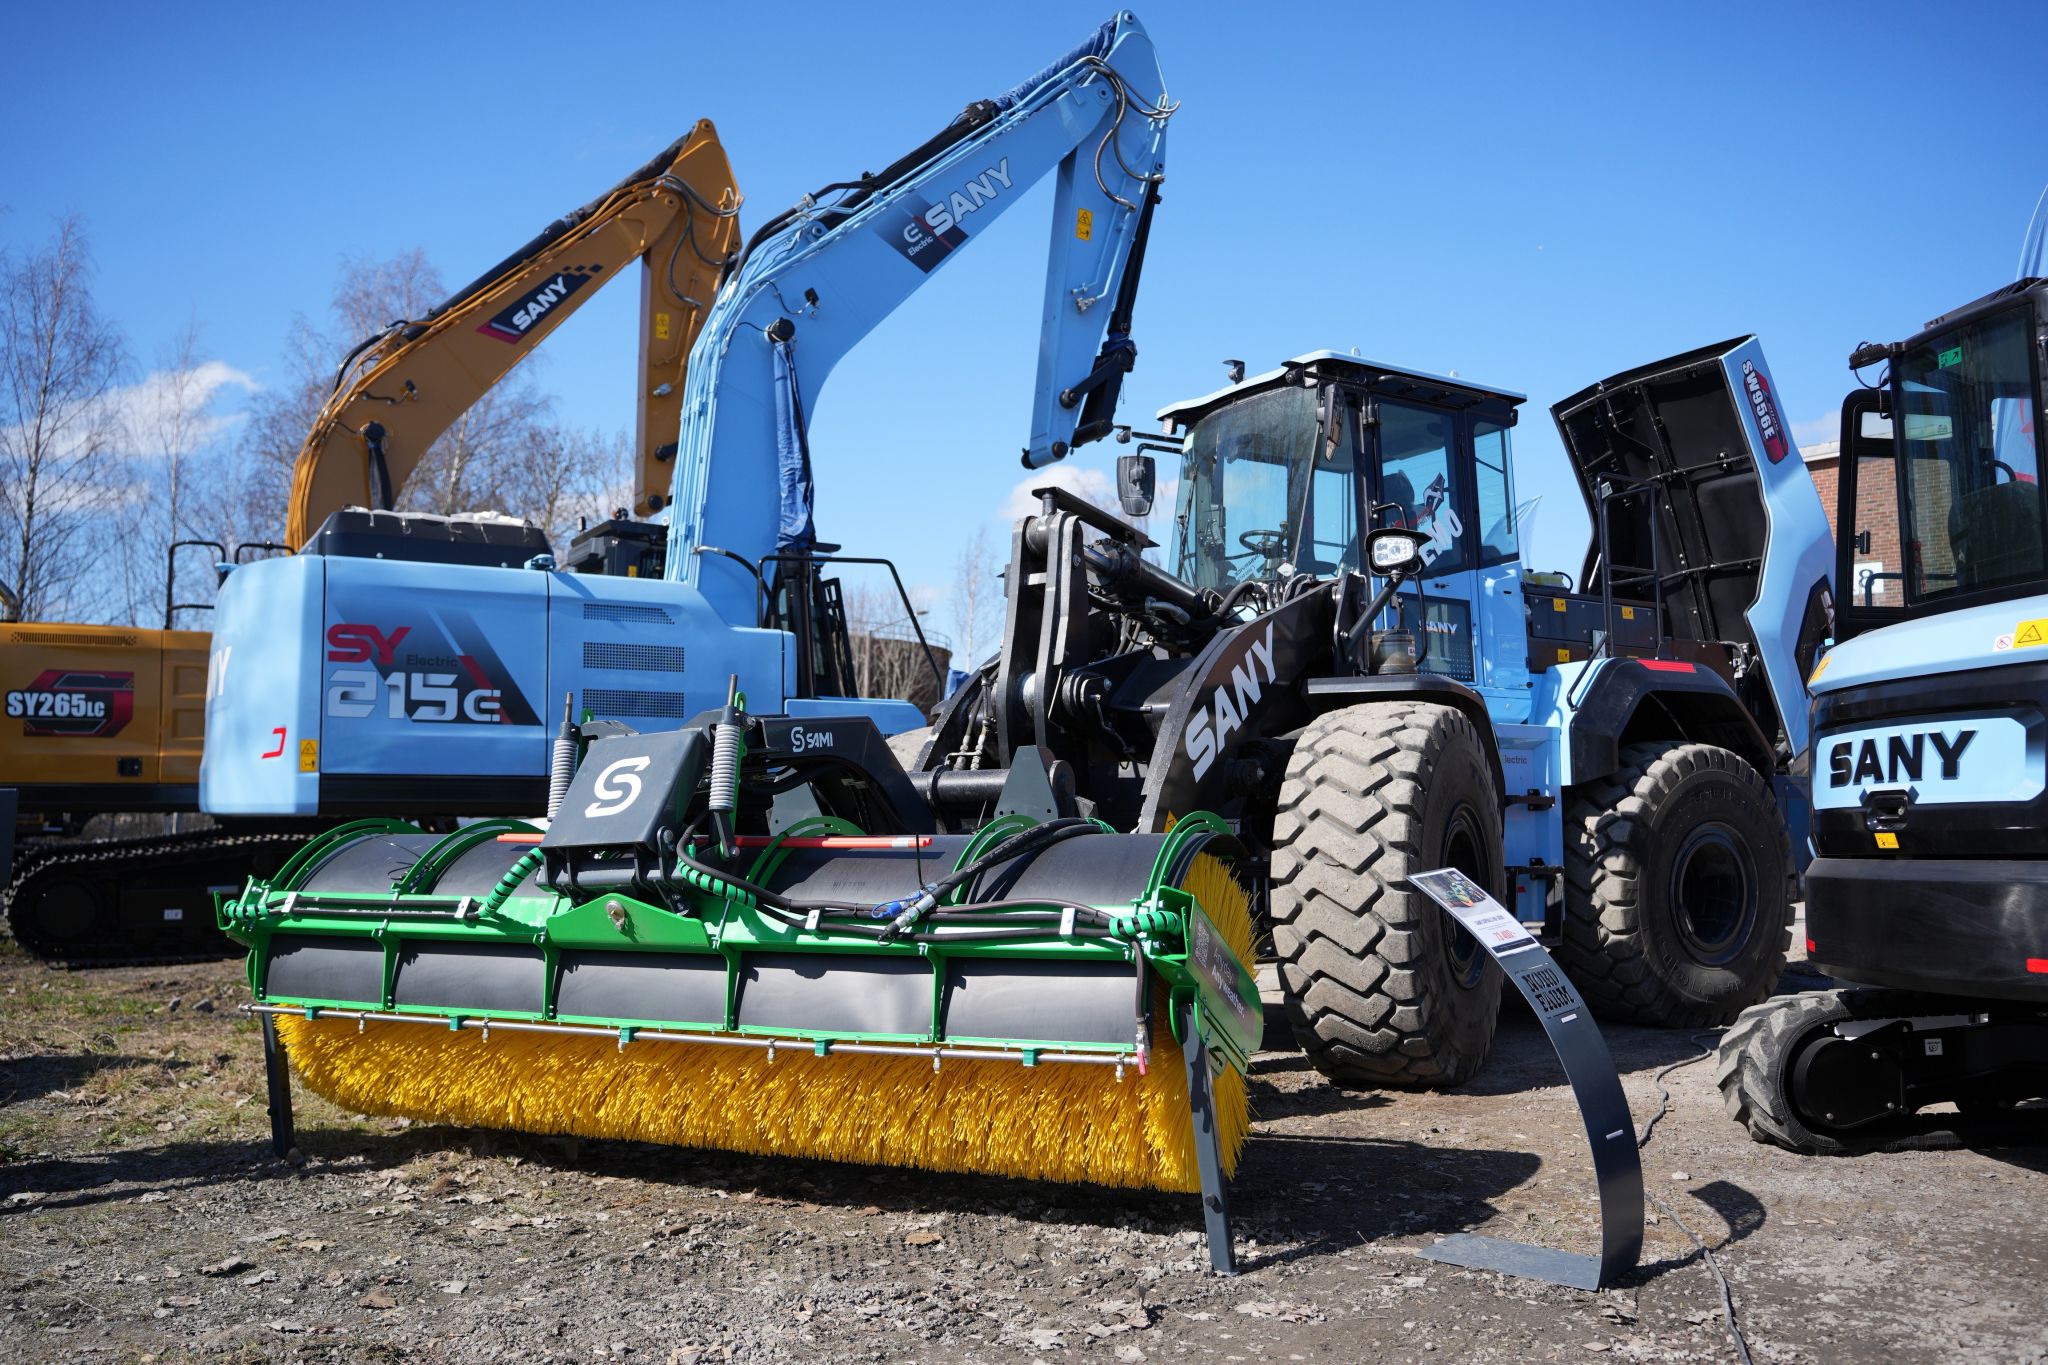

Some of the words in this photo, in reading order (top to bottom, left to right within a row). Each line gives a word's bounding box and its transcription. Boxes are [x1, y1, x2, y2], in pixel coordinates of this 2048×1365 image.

[923, 156, 1013, 237] SANY
[907, 235, 934, 257] Electric
[512, 275, 567, 330] SANY
[1742, 360, 1775, 439] SW956E
[327, 623, 413, 665] SY
[406, 654, 458, 668] Electric
[7, 691, 105, 717] SY265LC
[1185, 620, 1276, 783] SANY
[806, 731, 833, 749] SAMI
[1504, 754, 1527, 765] lectric
[1830, 728, 1979, 788] SANY
[1521, 967, 1560, 992] NORD
[1534, 985, 1575, 1012] FARM
